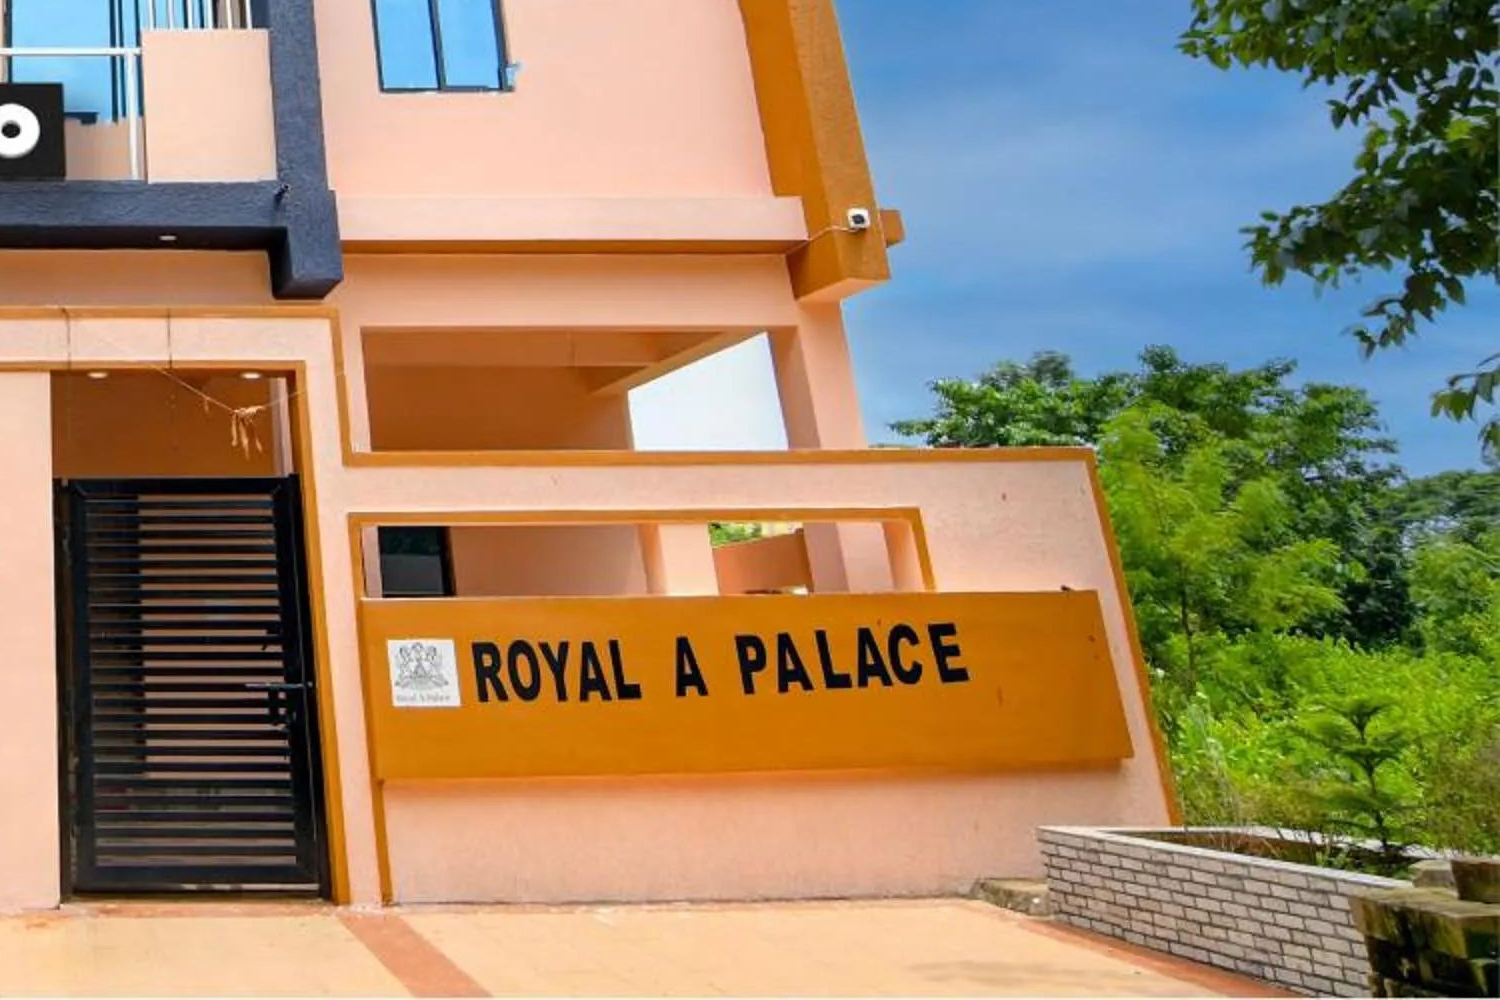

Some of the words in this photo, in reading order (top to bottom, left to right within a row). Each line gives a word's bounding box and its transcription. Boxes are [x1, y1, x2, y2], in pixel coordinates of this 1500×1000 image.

[471, 639, 643, 703] ROYAL
[675, 636, 709, 697] A
[734, 622, 970, 695] PALACE
